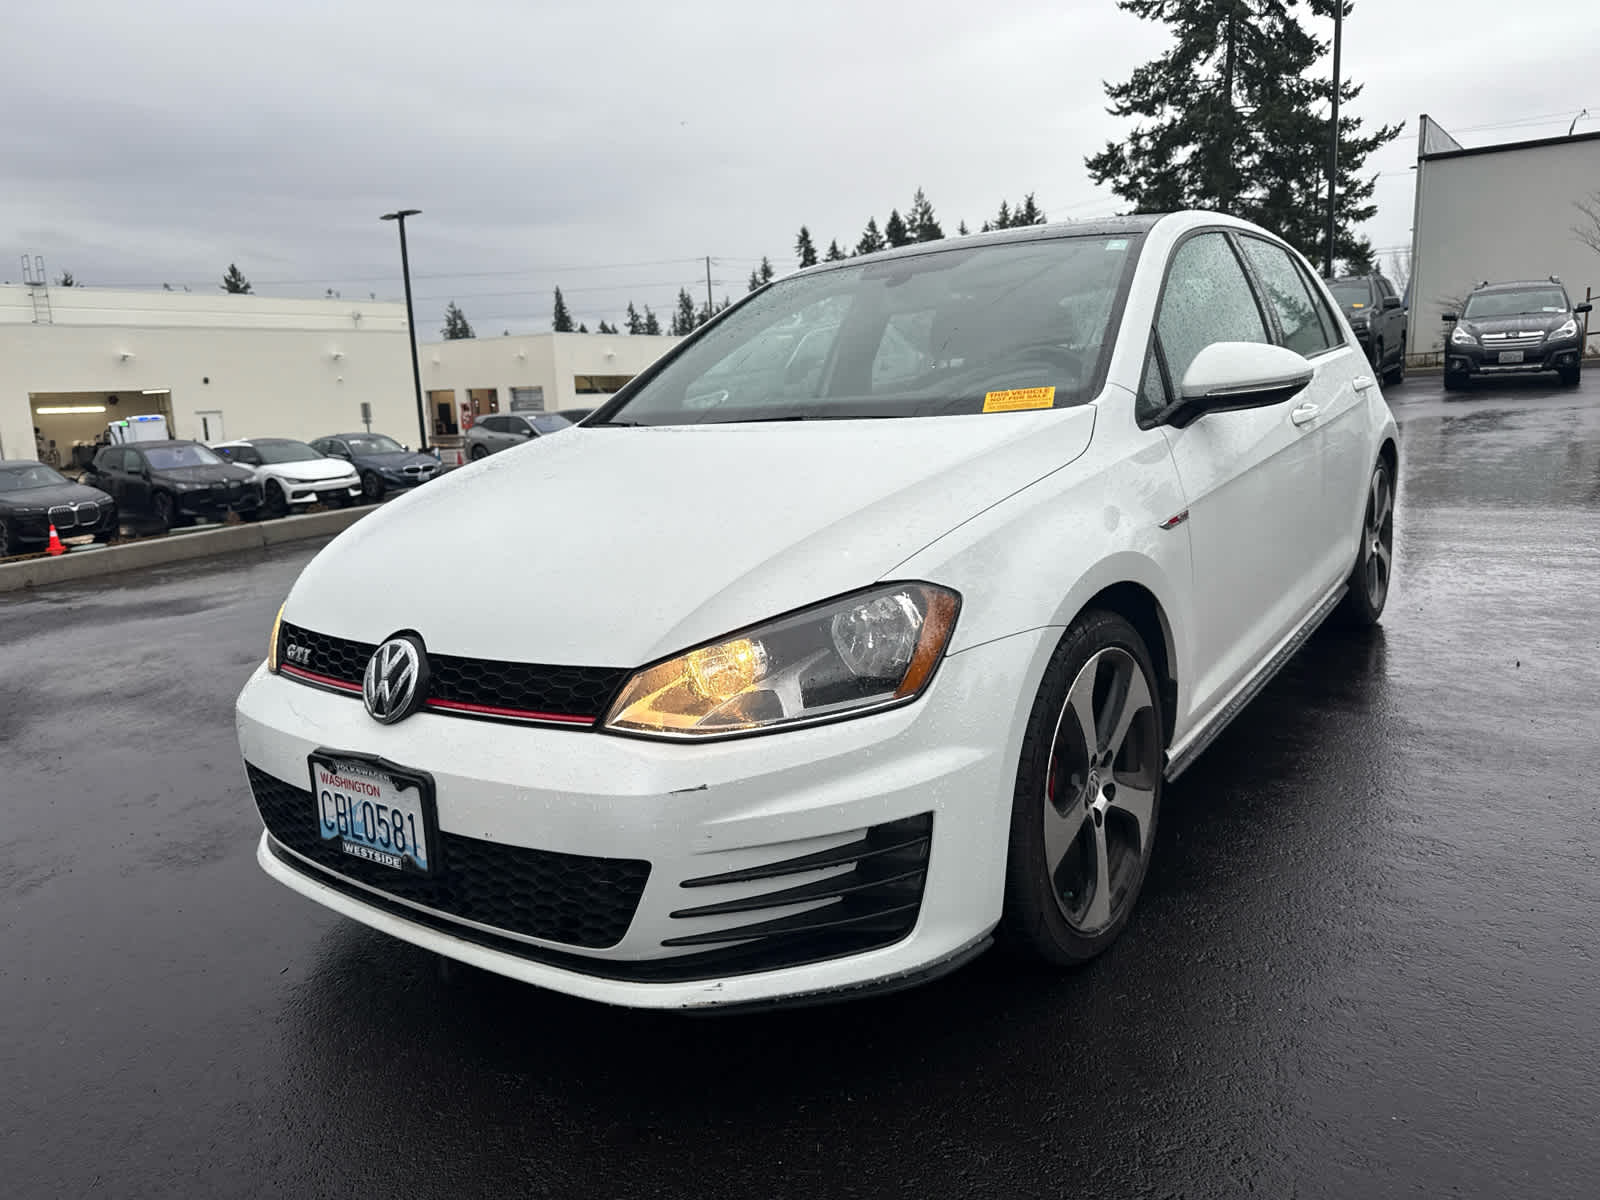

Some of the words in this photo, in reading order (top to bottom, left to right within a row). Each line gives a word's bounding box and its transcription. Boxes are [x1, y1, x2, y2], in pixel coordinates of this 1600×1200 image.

[286, 643, 312, 663] GTI
[320, 771, 381, 798] WASHINGTON
[321, 790, 418, 857] CBL0581
[343, 842, 401, 868] WESTSIDE
